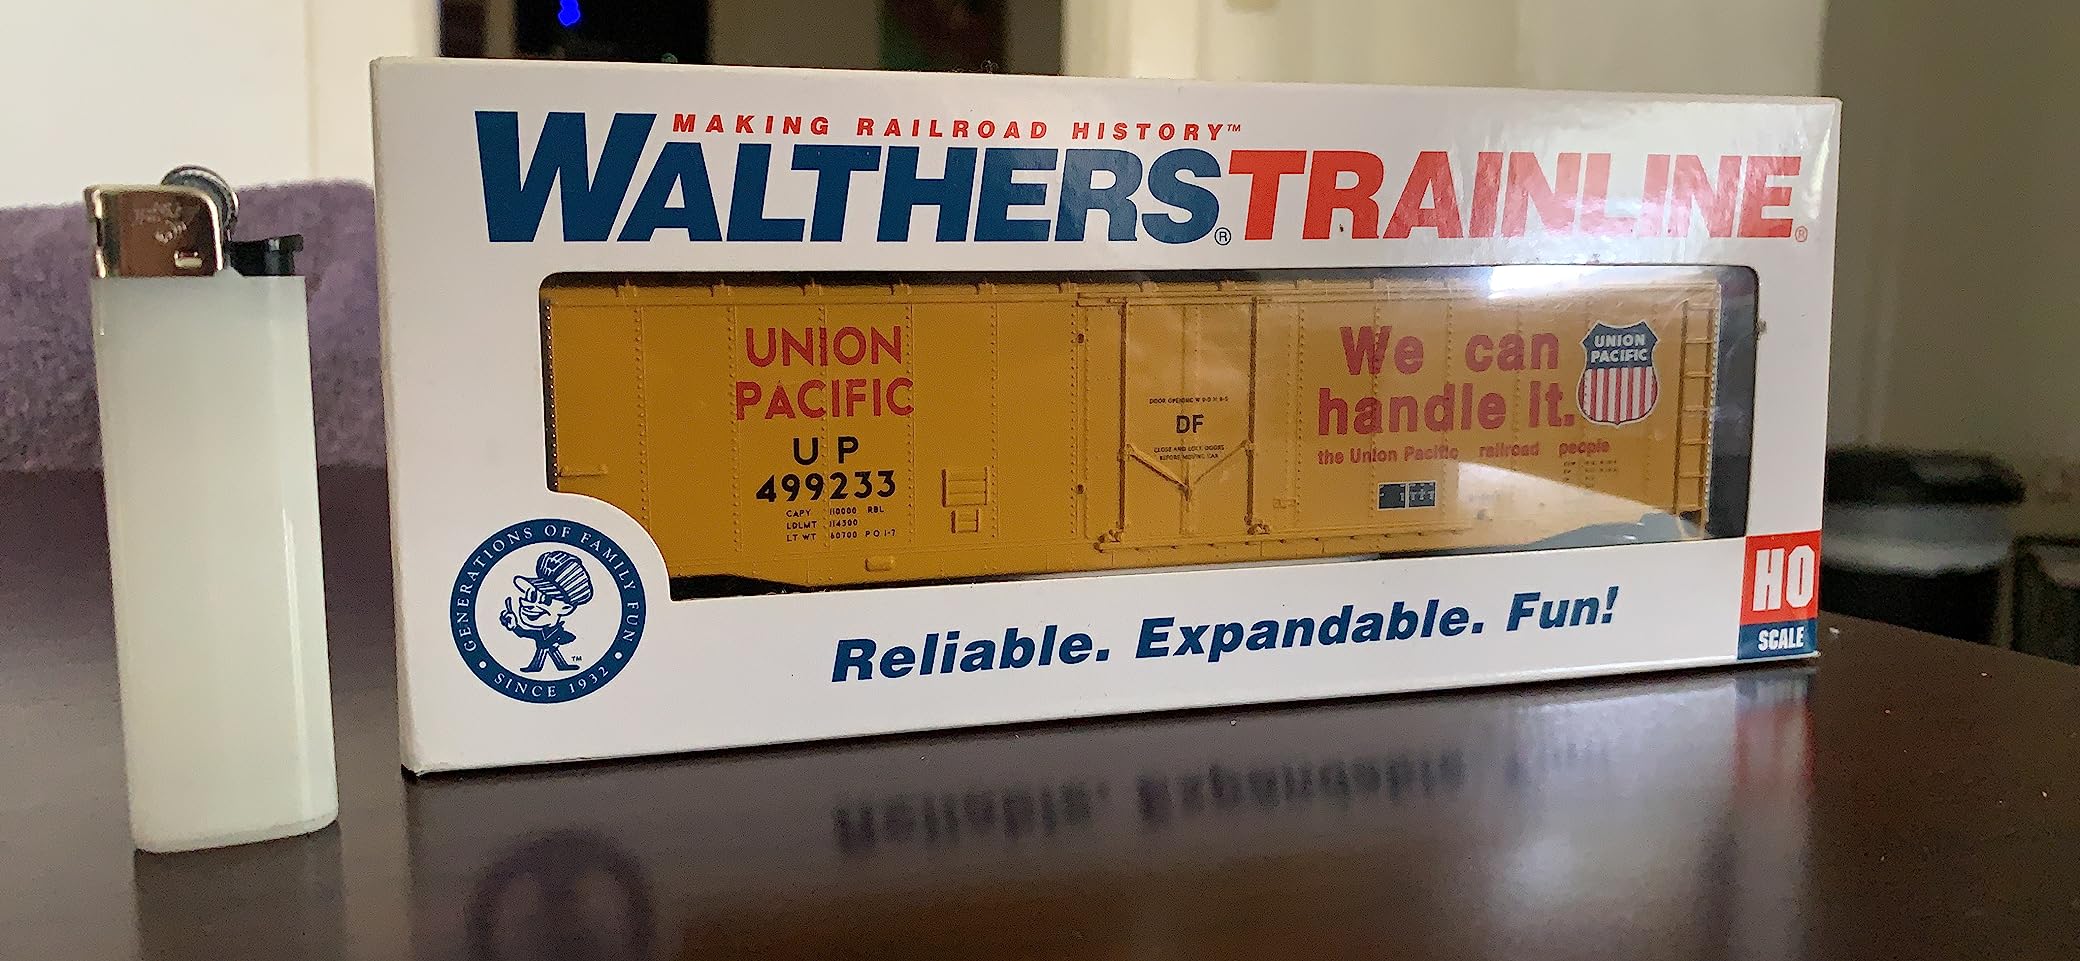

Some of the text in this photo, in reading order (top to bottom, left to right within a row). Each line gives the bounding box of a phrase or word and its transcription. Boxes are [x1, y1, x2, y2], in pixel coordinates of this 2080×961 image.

[673, 113, 829, 135] MAKING
[856, 117, 1048, 139] RAILROAD
[745, 326, 902, 368] UNION
[1340, 325, 1560, 376] We can
[1591, 348, 1648, 363] PACIFIC
[1594, 333, 1645, 348] UNION
[735, 377, 915, 421] PACIFIC
[1317, 383, 1507, 436] handle
[1176, 414, 1204, 434] DF
[793, 435, 859, 466] U P
[1317, 449, 1345, 465] the
[1350, 447, 1398, 464] Union
[755, 470, 897, 502] 499233
[786, 506, 885, 517] CAPY 110000 RBL
[786, 520, 818, 530] LDLMT
[786, 534, 798, 542] LT
[802, 533, 817, 541] WT
[830, 530, 858, 540] 60700
[456, 524, 640, 652] GENERATIONS OF FAMILY FUN
[1752, 544, 1816, 612] HO
[831, 585, 1620, 683] Reliable. Expandable. Fun!
[1757, 625, 1806, 652] SCALE
[494, 665, 609, 698] SINCE 1932
